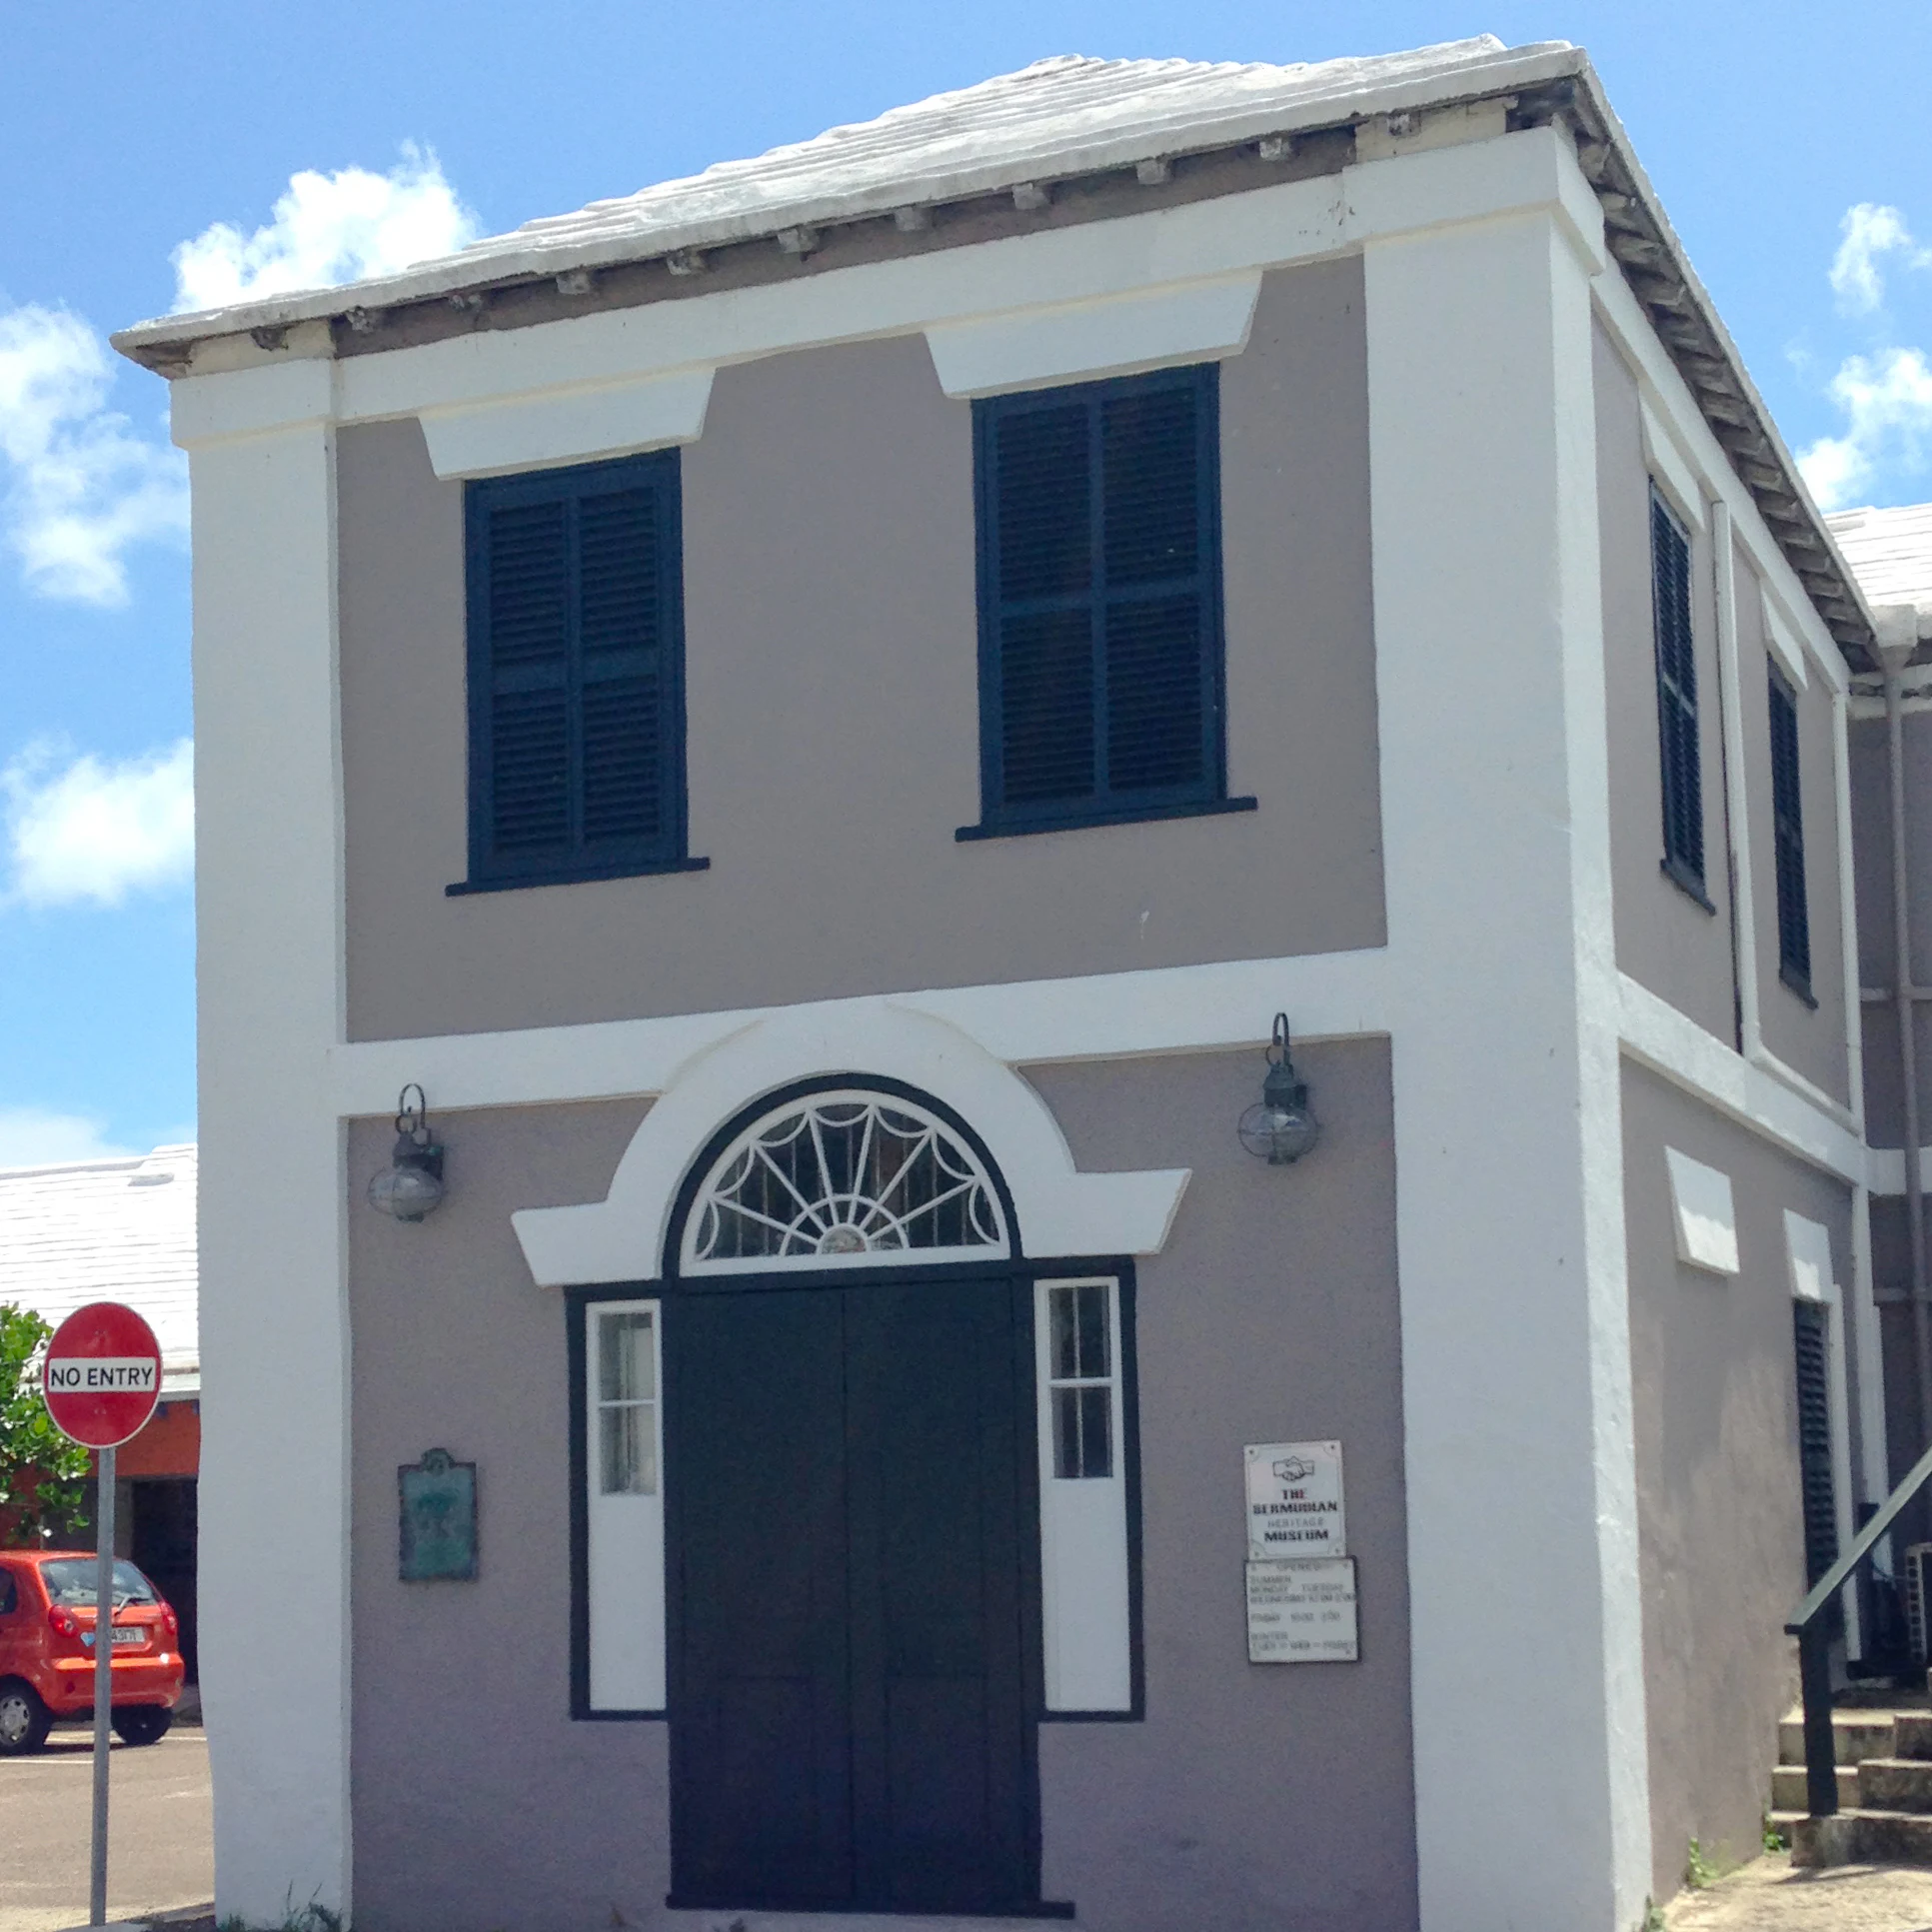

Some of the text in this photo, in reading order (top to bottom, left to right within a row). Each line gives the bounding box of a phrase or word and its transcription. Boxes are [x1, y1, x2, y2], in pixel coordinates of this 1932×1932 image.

[51, 1366, 153, 1386] NO ENTRY
[1281, 1488, 1307, 1499] THE
[1252, 1500, 1337, 1514] BERMUDIAN
[1267, 1517, 1324, 1527] HERITAGE
[1264, 1529, 1328, 1542] MUSEUM
